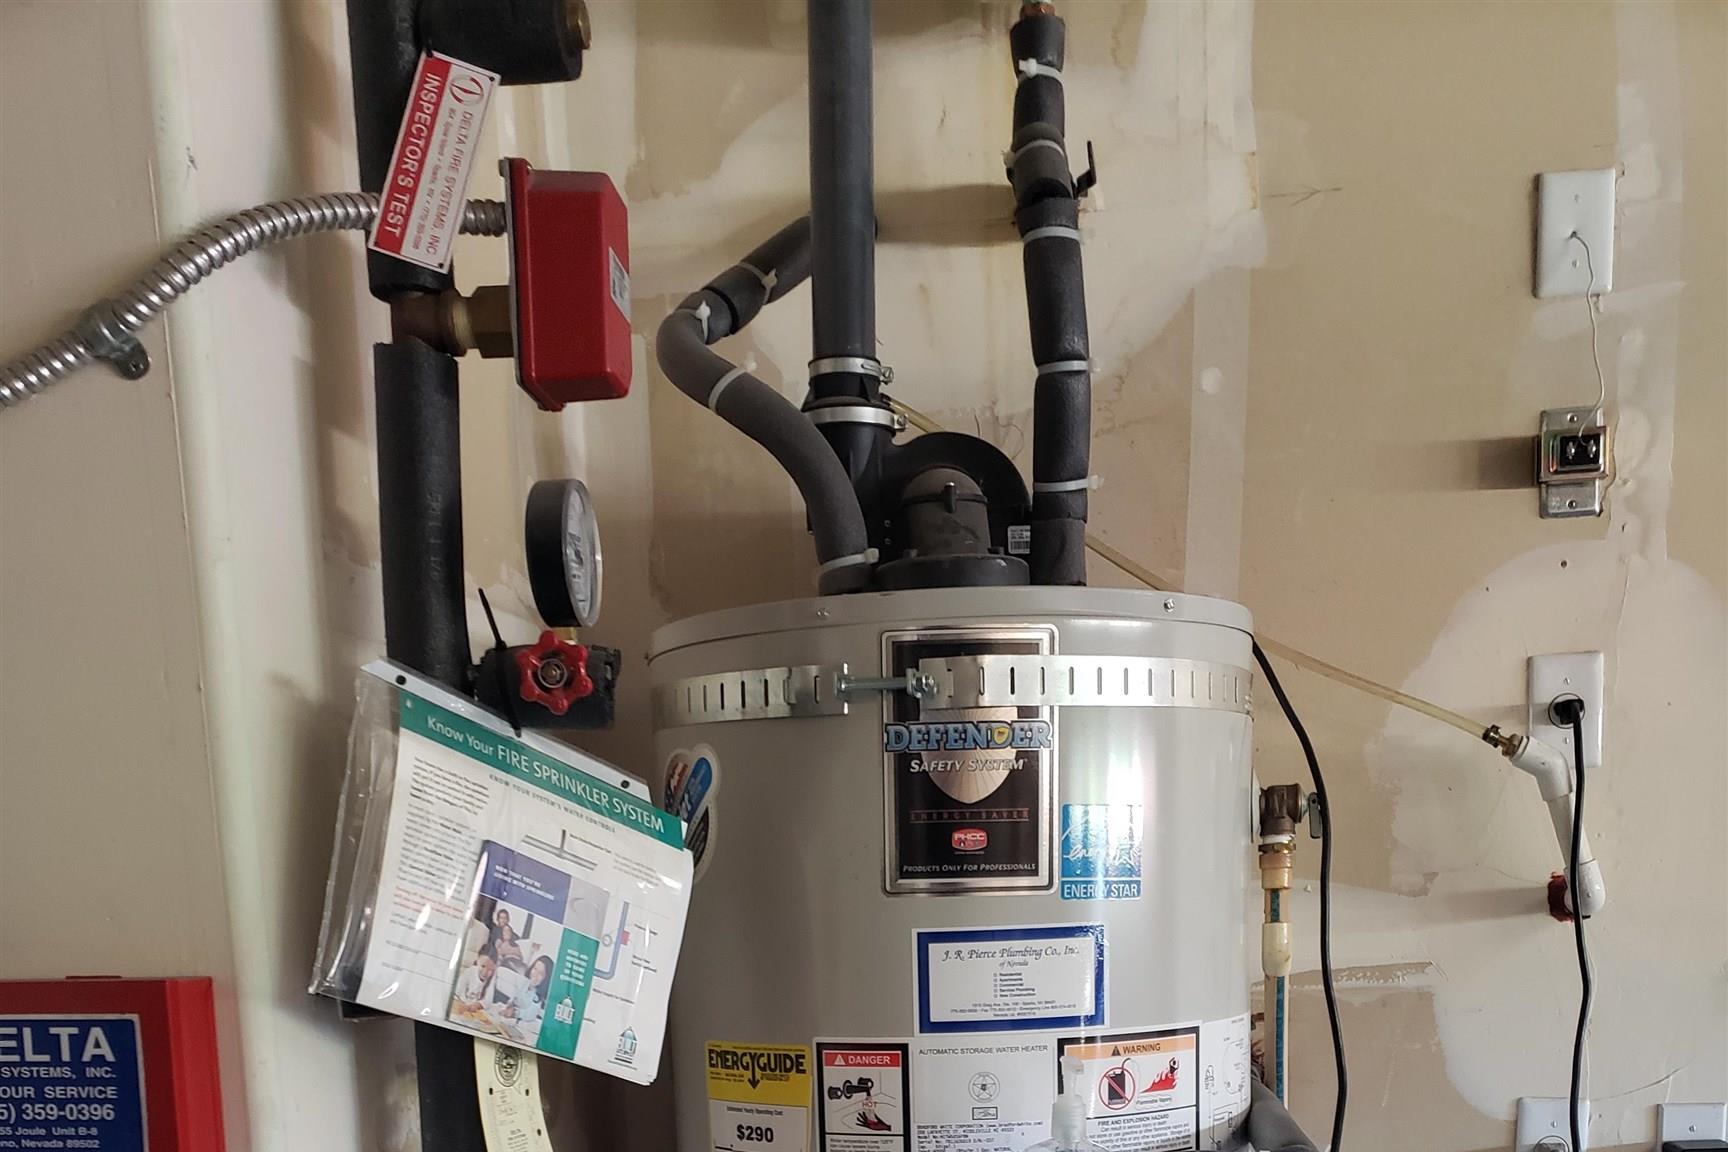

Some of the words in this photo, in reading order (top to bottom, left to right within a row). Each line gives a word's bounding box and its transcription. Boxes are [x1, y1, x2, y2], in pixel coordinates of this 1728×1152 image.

[397, 72, 442, 189] INSPECTOR'S
[456, 111, 473, 148] DELTA
[448, 148, 464, 171] FIRE
[384, 191, 410, 238] TEST
[886, 720, 1053, 752] DEFENDER
[910, 759, 965, 772] SAFETY
[967, 758, 1025, 771] SYSTEM
[427, 715, 464, 742] Know
[465, 733, 494, 756] Your
[497, 744, 529, 773] FIRE
[532, 761, 610, 809] SPRINKLER
[612, 797, 665, 834] SYSTEM
[954, 832, 985, 840] PHCC
[1111, 883, 1138, 897] STAR
[967, 949, 997, 960] Pierce
[999, 946, 1043, 960] Plumbing
[1123, 1043, 1161, 1054] WARNING
[708, 1048, 807, 1075] ENERGYGUIDE
[848, 1055, 891, 1065] DANGER
[1, 1066, 76, 1079] SYSTEMS,
[86, 1066, 116, 1078] INC.
[44, 1086, 118, 1098] SERVICE
[22, 1103, 115, 1120] 359-0396
[862, 1101, 877, 1109] HOT
[15, 1127, 46, 1135] Joule
[52, 1127, 75, 1135] Unit
[736, 1124, 774, 1143] $290
[21, 1139, 64, 1148] Nevada
